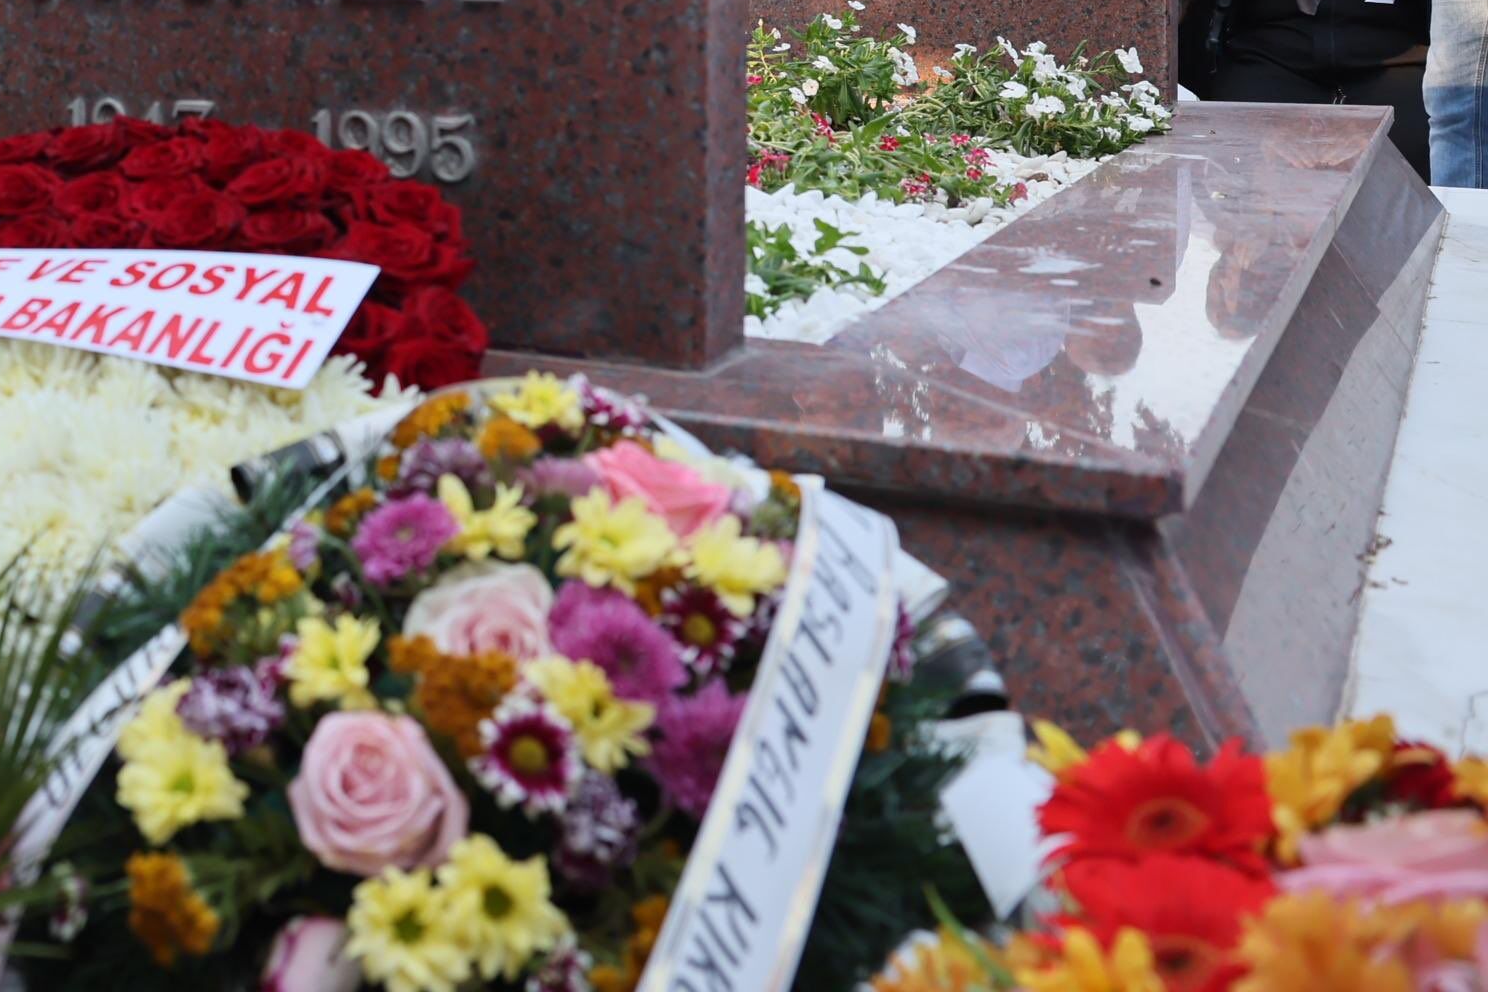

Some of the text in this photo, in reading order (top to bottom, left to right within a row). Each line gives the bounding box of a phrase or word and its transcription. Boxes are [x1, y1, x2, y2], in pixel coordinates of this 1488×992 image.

[311, 109, 476, 184] 1995
[27, 258, 110, 284] VE
[110, 260, 337, 318] SOSYAL
[0, 298, 316, 380] BAKANLIĞI
